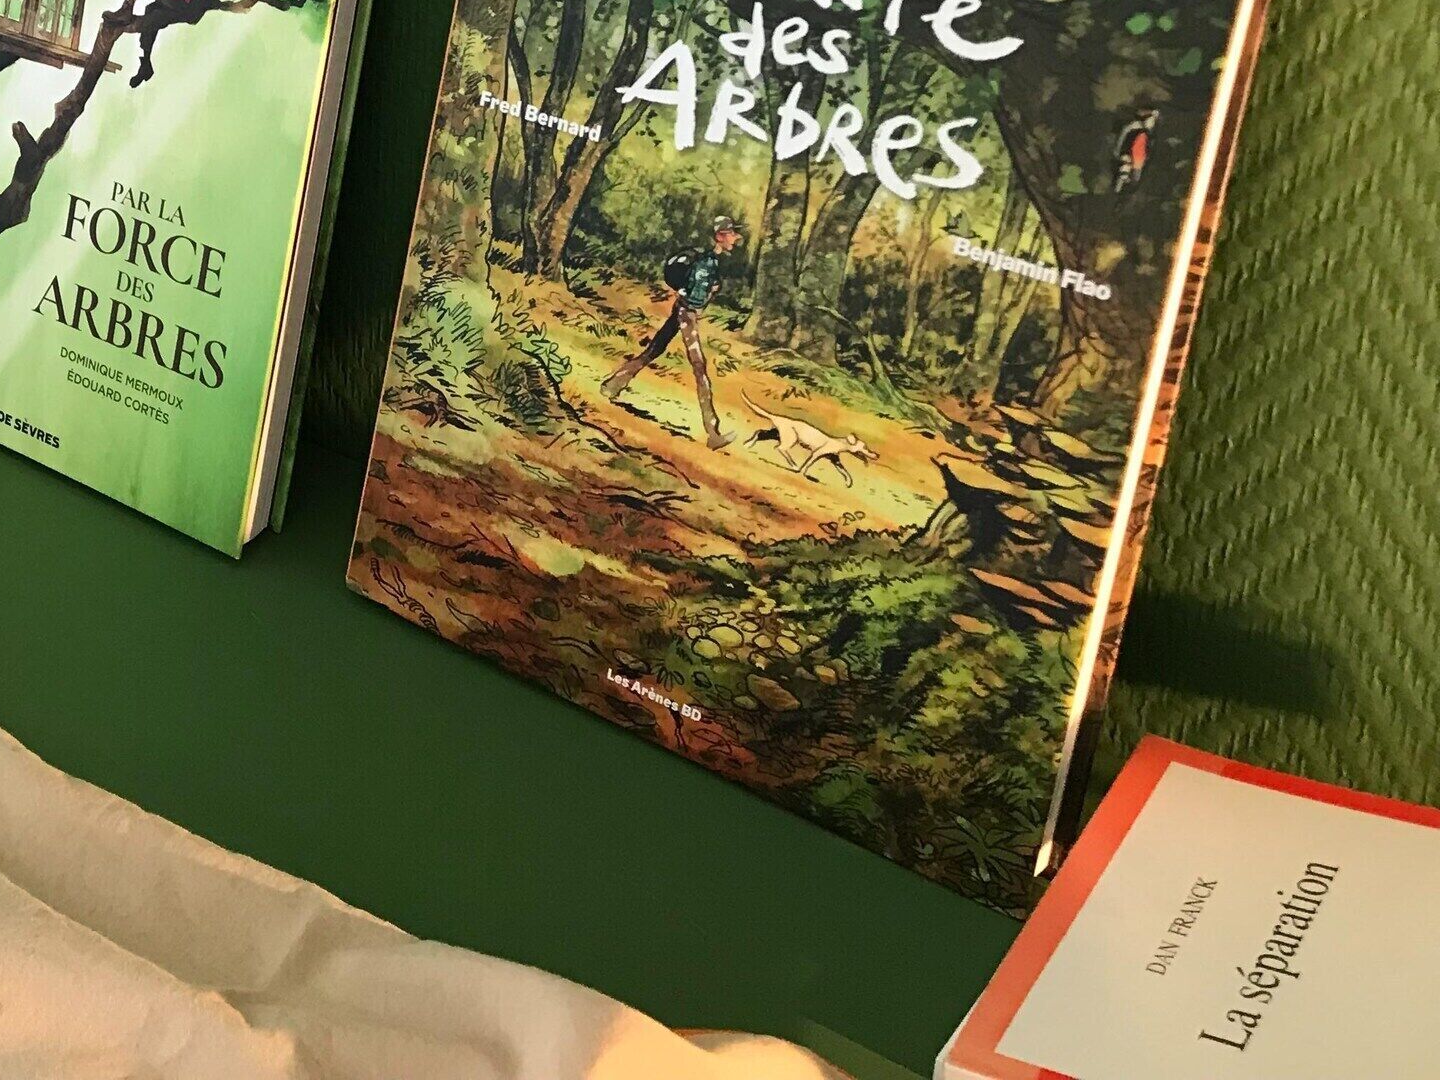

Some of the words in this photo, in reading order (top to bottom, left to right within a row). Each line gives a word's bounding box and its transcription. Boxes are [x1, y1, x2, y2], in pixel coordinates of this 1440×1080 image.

[719, 2, 851, 81] des
[480, 90, 522, 117] Fred
[524, 104, 602, 142] Bernard
[111, 182, 151, 214] PAR
[158, 199, 187, 227] LA
[61, 193, 226, 298] FORCE
[951, 235, 1060, 284] Benjamin
[1061, 269, 1112, 300] Flao
[117, 271, 154, 302] DES
[31, 275, 227, 390] ARBRES
[60, 346, 123, 383] DOMINIQUE
[125, 375, 184, 410] MERMOUX
[67, 368, 121, 402] ÉDOUARD
[13, 418, 60, 449] SÈVRES
[607, 668, 630, 688] Les
[630, 681, 679, 712] Arènes
[681, 703, 702, 721] BD
[1145, 939, 1180, 976] DAN
[1168, 877, 1218, 937] FRANCK
[1197, 1008, 1262, 1052] La
[1237, 862, 1339, 1004] séparation
